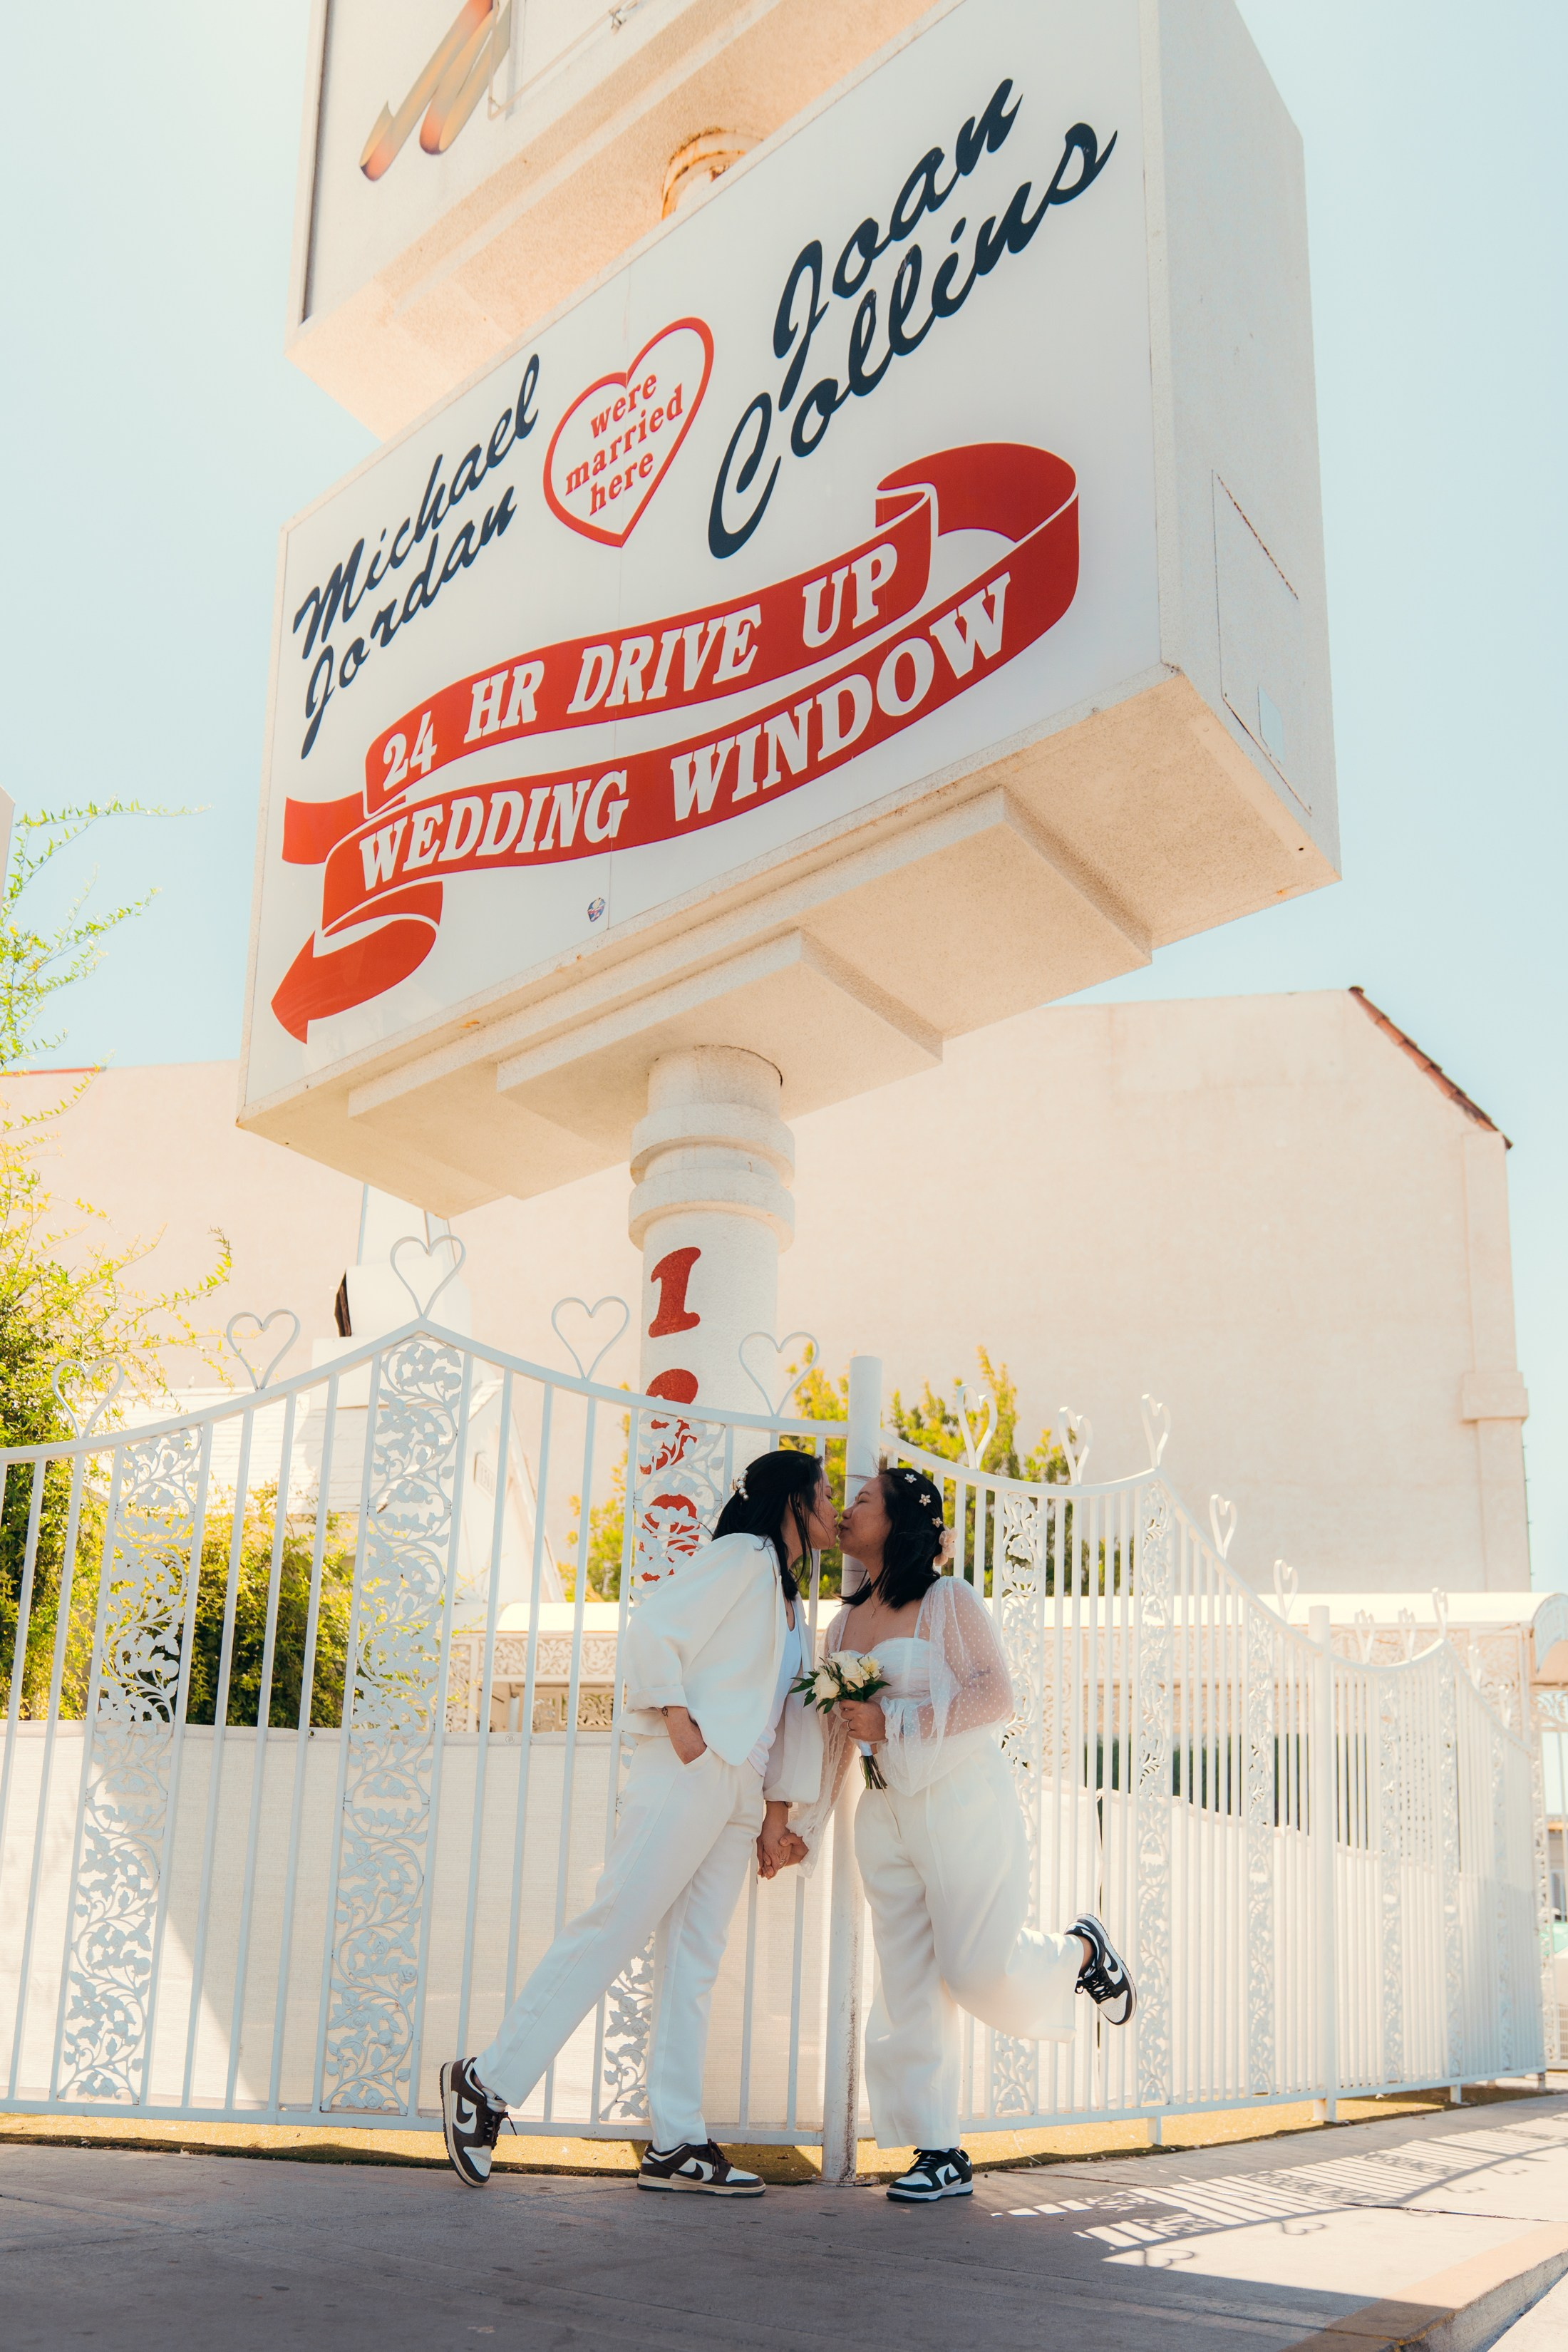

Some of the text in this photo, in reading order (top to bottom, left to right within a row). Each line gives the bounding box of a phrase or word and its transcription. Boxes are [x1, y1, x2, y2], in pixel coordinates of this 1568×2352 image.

[708, 123, 1118, 559] Collins
[773, 78, 1023, 412] Joan
[293, 354, 540, 659] Michael
[565, 383, 683, 496] married
[589, 453, 654, 516] here
[590, 372, 656, 438] were
[301, 485, 517, 760] Jordan
[359, 571, 1011, 892] WEDDING WINDOW
[382, 542, 898, 791] 24 HR DRIVE UP
